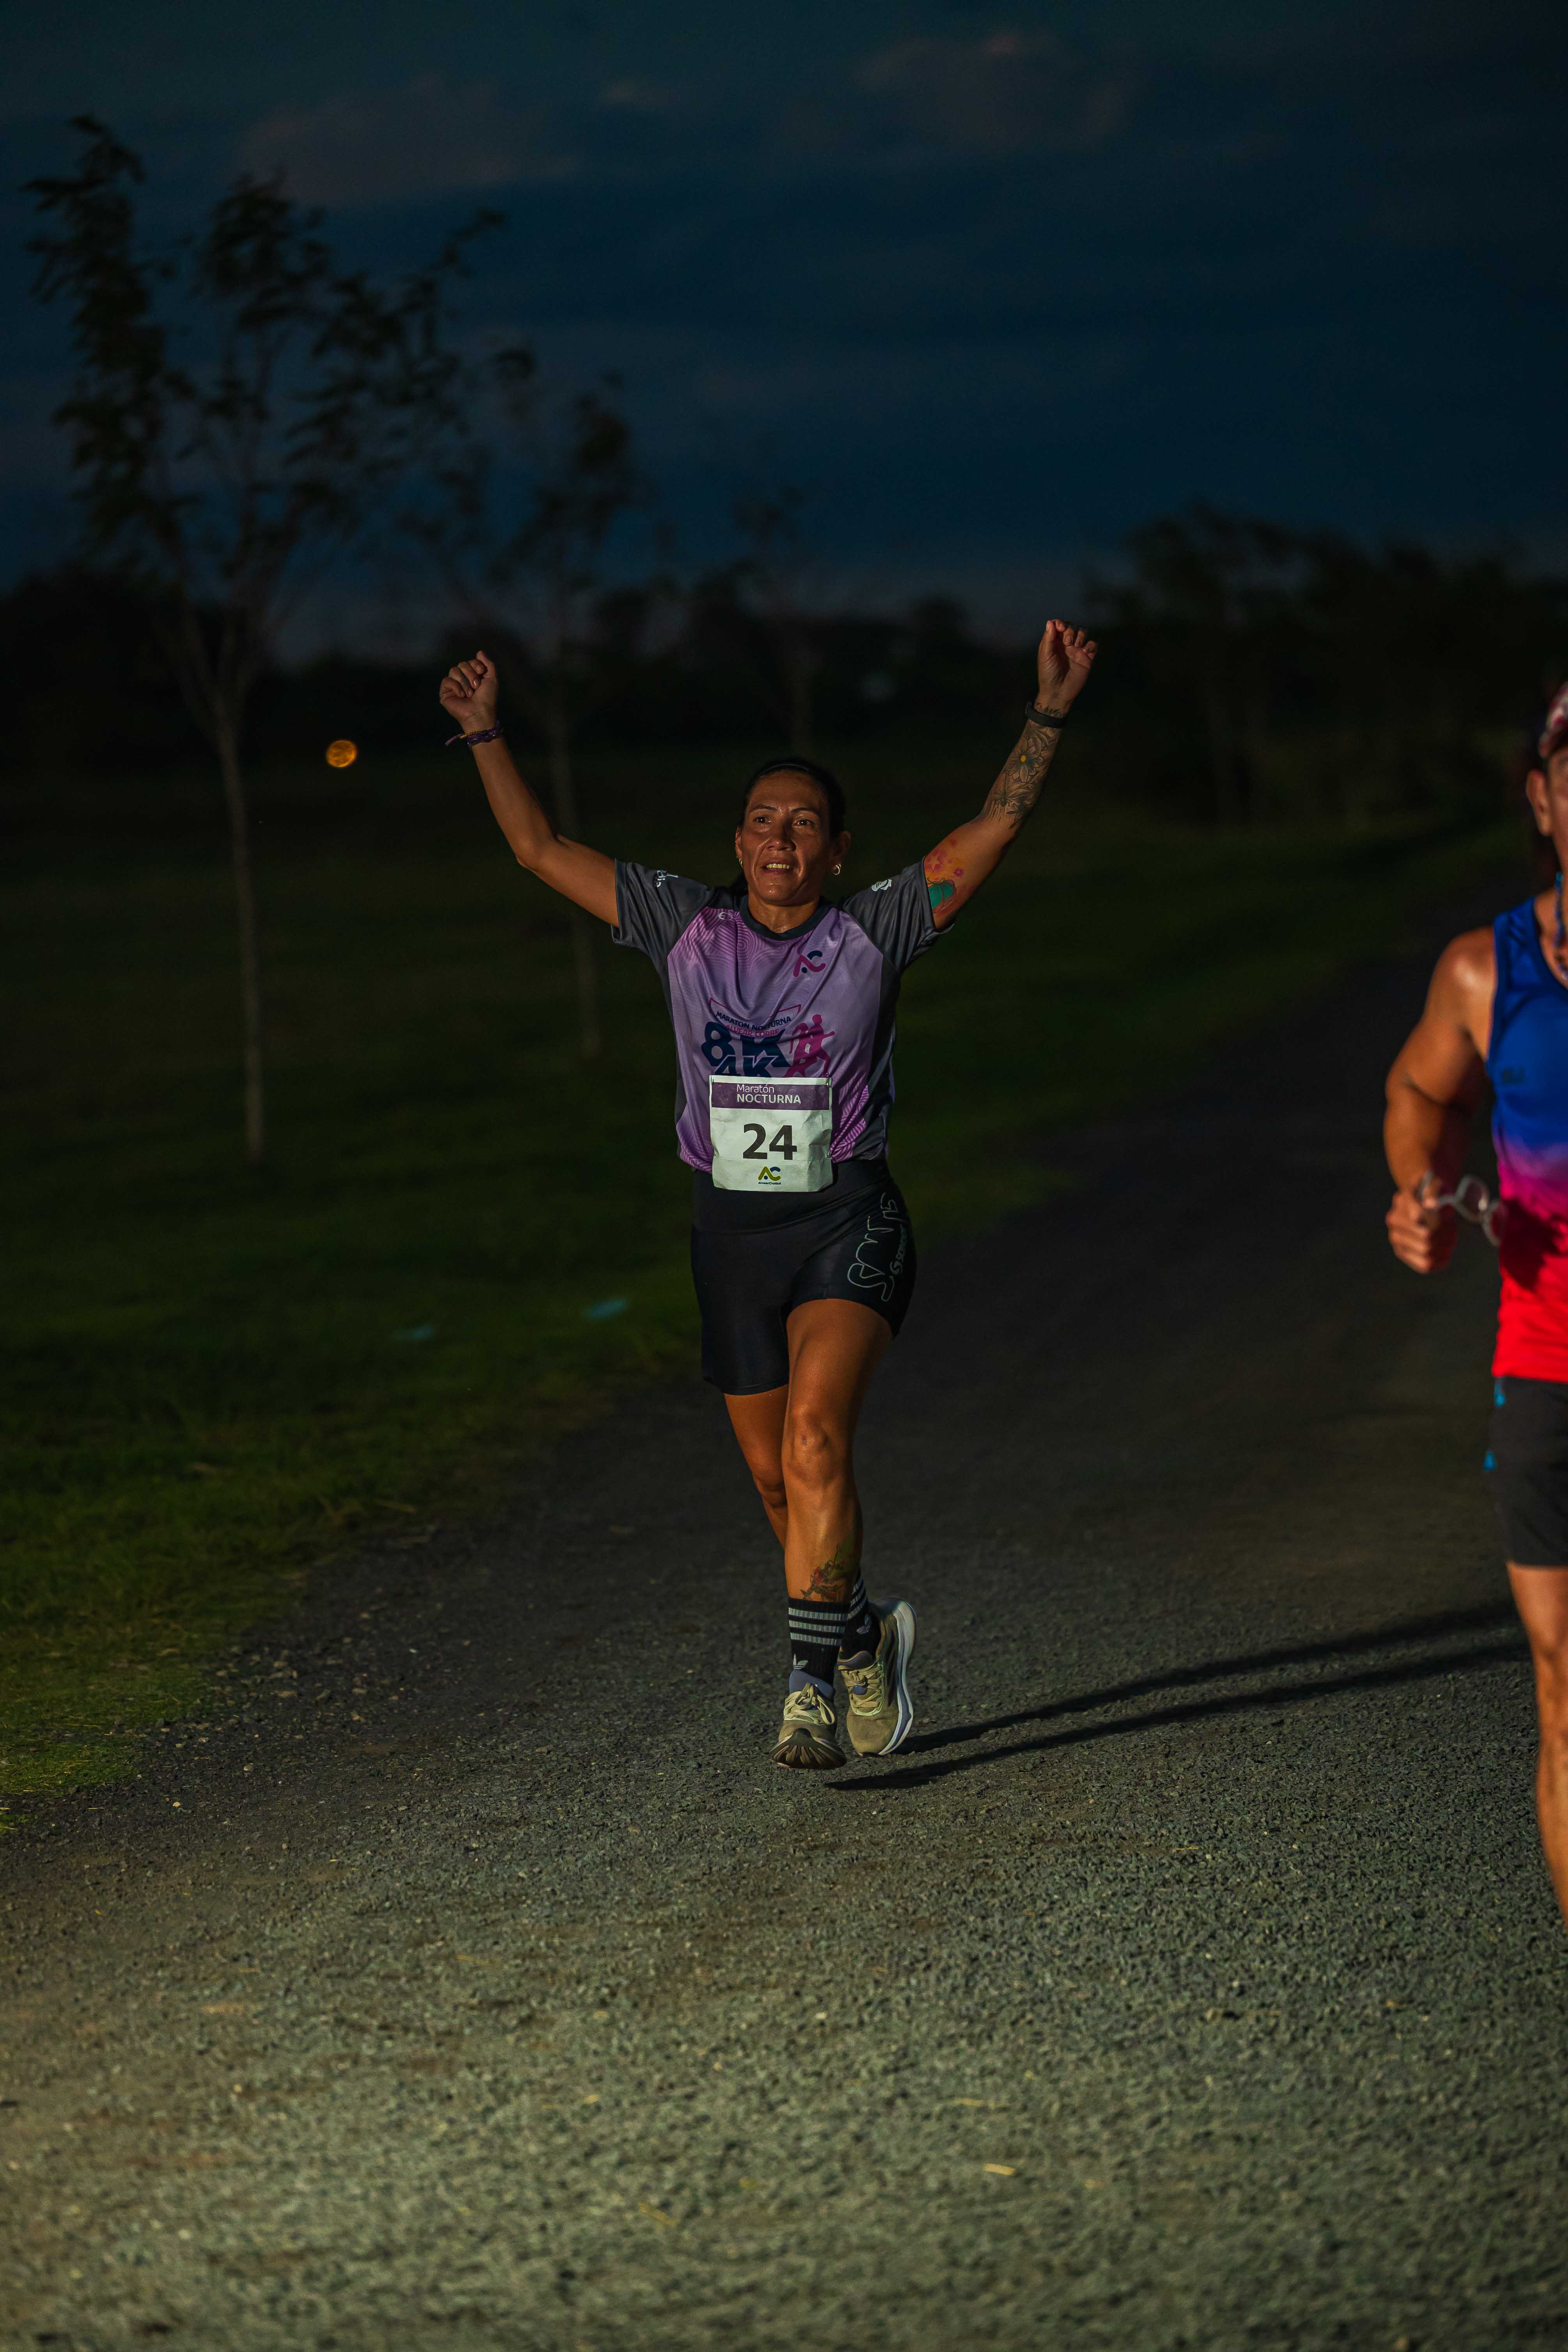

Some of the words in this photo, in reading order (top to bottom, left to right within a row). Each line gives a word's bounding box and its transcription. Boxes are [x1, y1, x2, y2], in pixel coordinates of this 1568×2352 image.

[716, 1011, 749, 1029] MARATON
[726, 1024, 752, 1036] ALVEAR
[755, 1029, 779, 1037] CORRE
[701, 1021, 792, 1068] 8K
[715, 1055, 779, 1078] 4K
[737, 1084, 774, 1093] Maratón
[737, 1093, 801, 1104] NOCTURNA
[742, 1123, 797, 1160] 24
